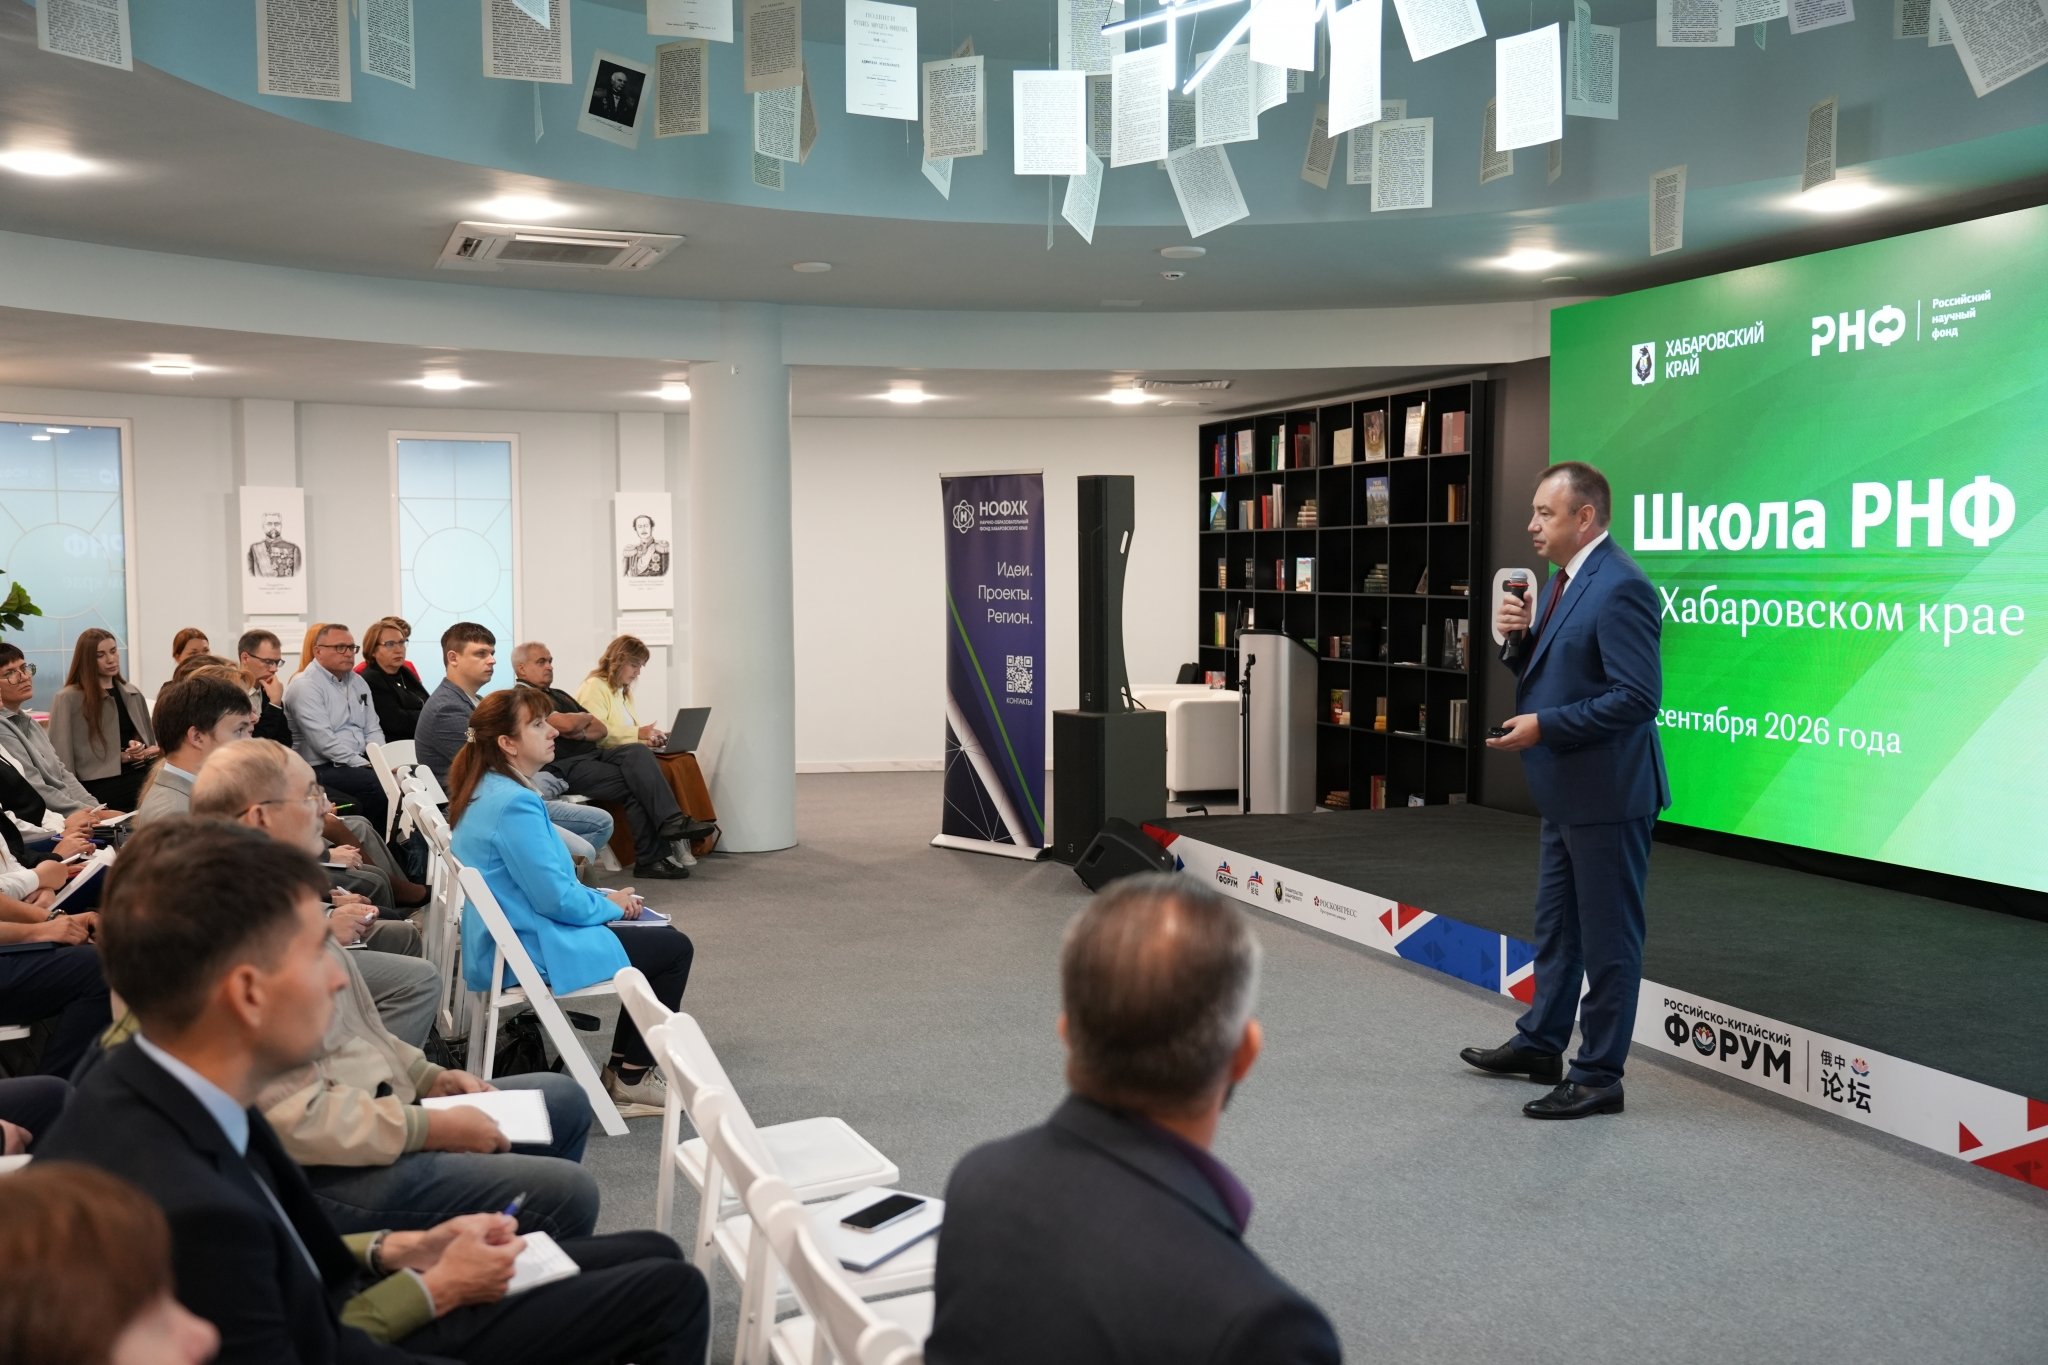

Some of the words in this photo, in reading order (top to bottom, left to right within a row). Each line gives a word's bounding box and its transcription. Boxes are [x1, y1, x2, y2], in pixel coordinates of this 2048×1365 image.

[1932, 289, 1992, 309] Российский
[1931, 307, 1977, 325] научный
[1665, 320, 1765, 358] ХАБАРОВСКИЙ
[1811, 304, 1906, 357] РНФ
[1931, 327, 1959, 341] фонд
[1665, 353, 1700, 379] КРАЙ
[979, 500, 1029, 517] НОФХК
[1633, 492, 1826, 551] Школа
[1851, 475, 2016, 549] РНФ
[997, 561, 1033, 578] Идеи.
[978, 585, 1033, 603] Проекты.
[987, 608, 1033, 625] Регион.
[1659, 584, 1904, 638] Хабаровском
[1919, 602, 2025, 648] крае
[1006, 697, 1033, 706] КОНТАКТЫ
[1655, 706, 1758, 743] сентября
[1764, 711, 1830, 745] 2026
[1838, 726, 1902, 757] года
[1664, 998, 1791, 1048] РОССИЙСКО-КИТАЙСКИЙ
[1664, 1012, 1791, 1085] ФОРУМ
[1821, 1049, 1846, 1071] 俄中
[1821, 1069, 1871, 1114] 论坛
